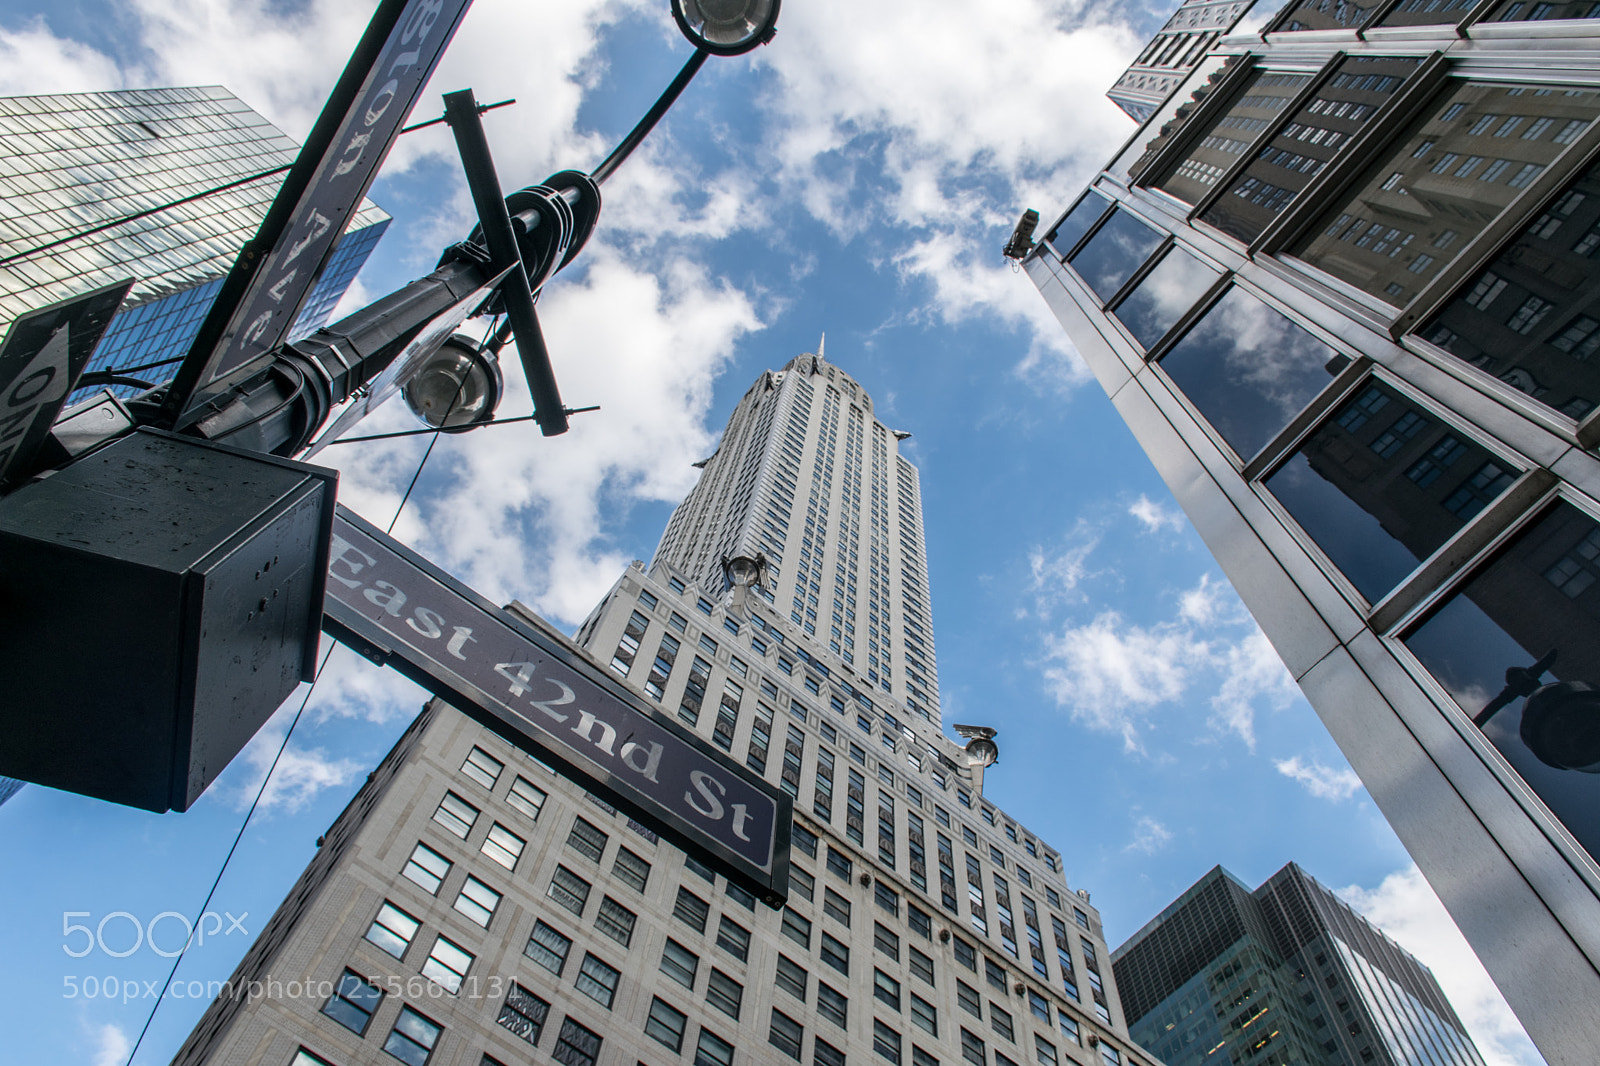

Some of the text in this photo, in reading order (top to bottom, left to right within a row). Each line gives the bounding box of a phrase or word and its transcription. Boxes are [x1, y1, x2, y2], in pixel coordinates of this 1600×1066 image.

[240, 207, 331, 351] Ave
[328, 532, 754, 842] East 42nd St
